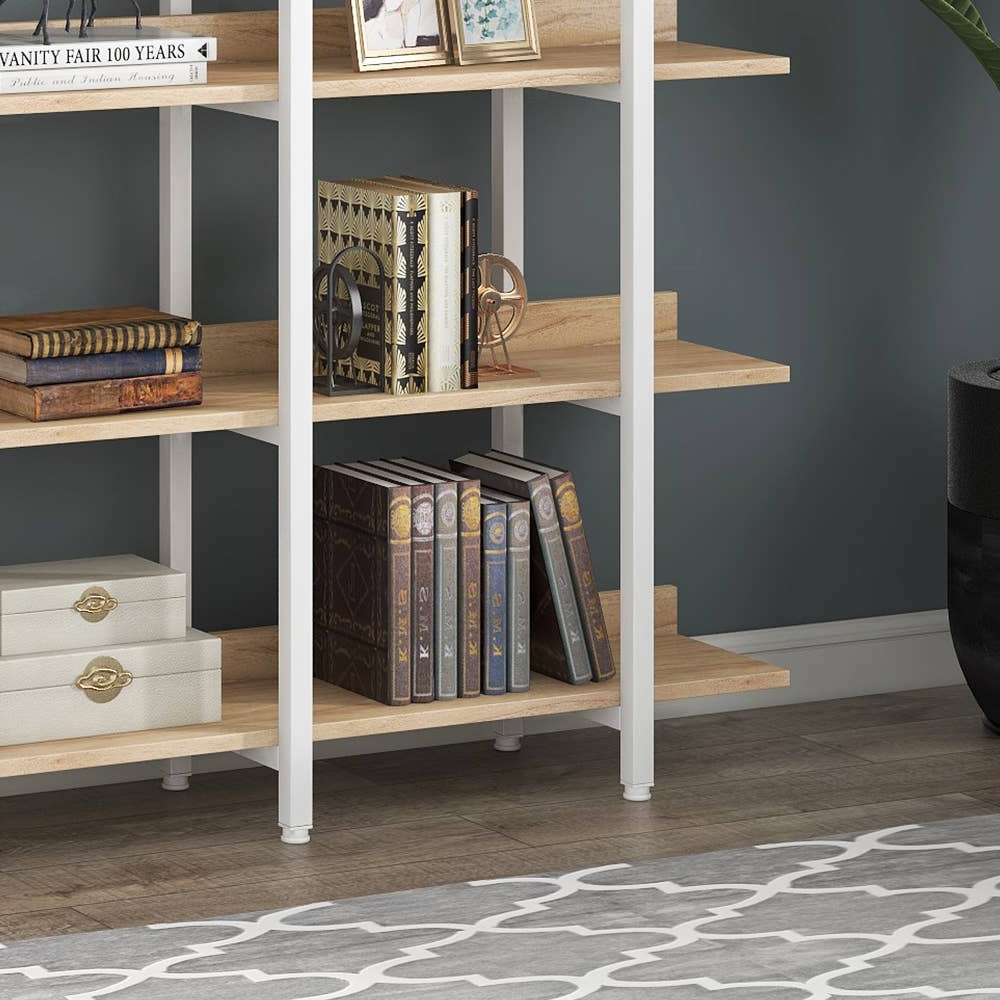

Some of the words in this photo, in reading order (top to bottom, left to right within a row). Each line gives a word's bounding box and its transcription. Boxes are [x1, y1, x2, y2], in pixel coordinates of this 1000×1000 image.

[66, 47, 103, 65] FAIR
[107, 46, 130, 62] 100
[135, 43, 185, 61] YEARS
[51, 76, 75, 85] and
